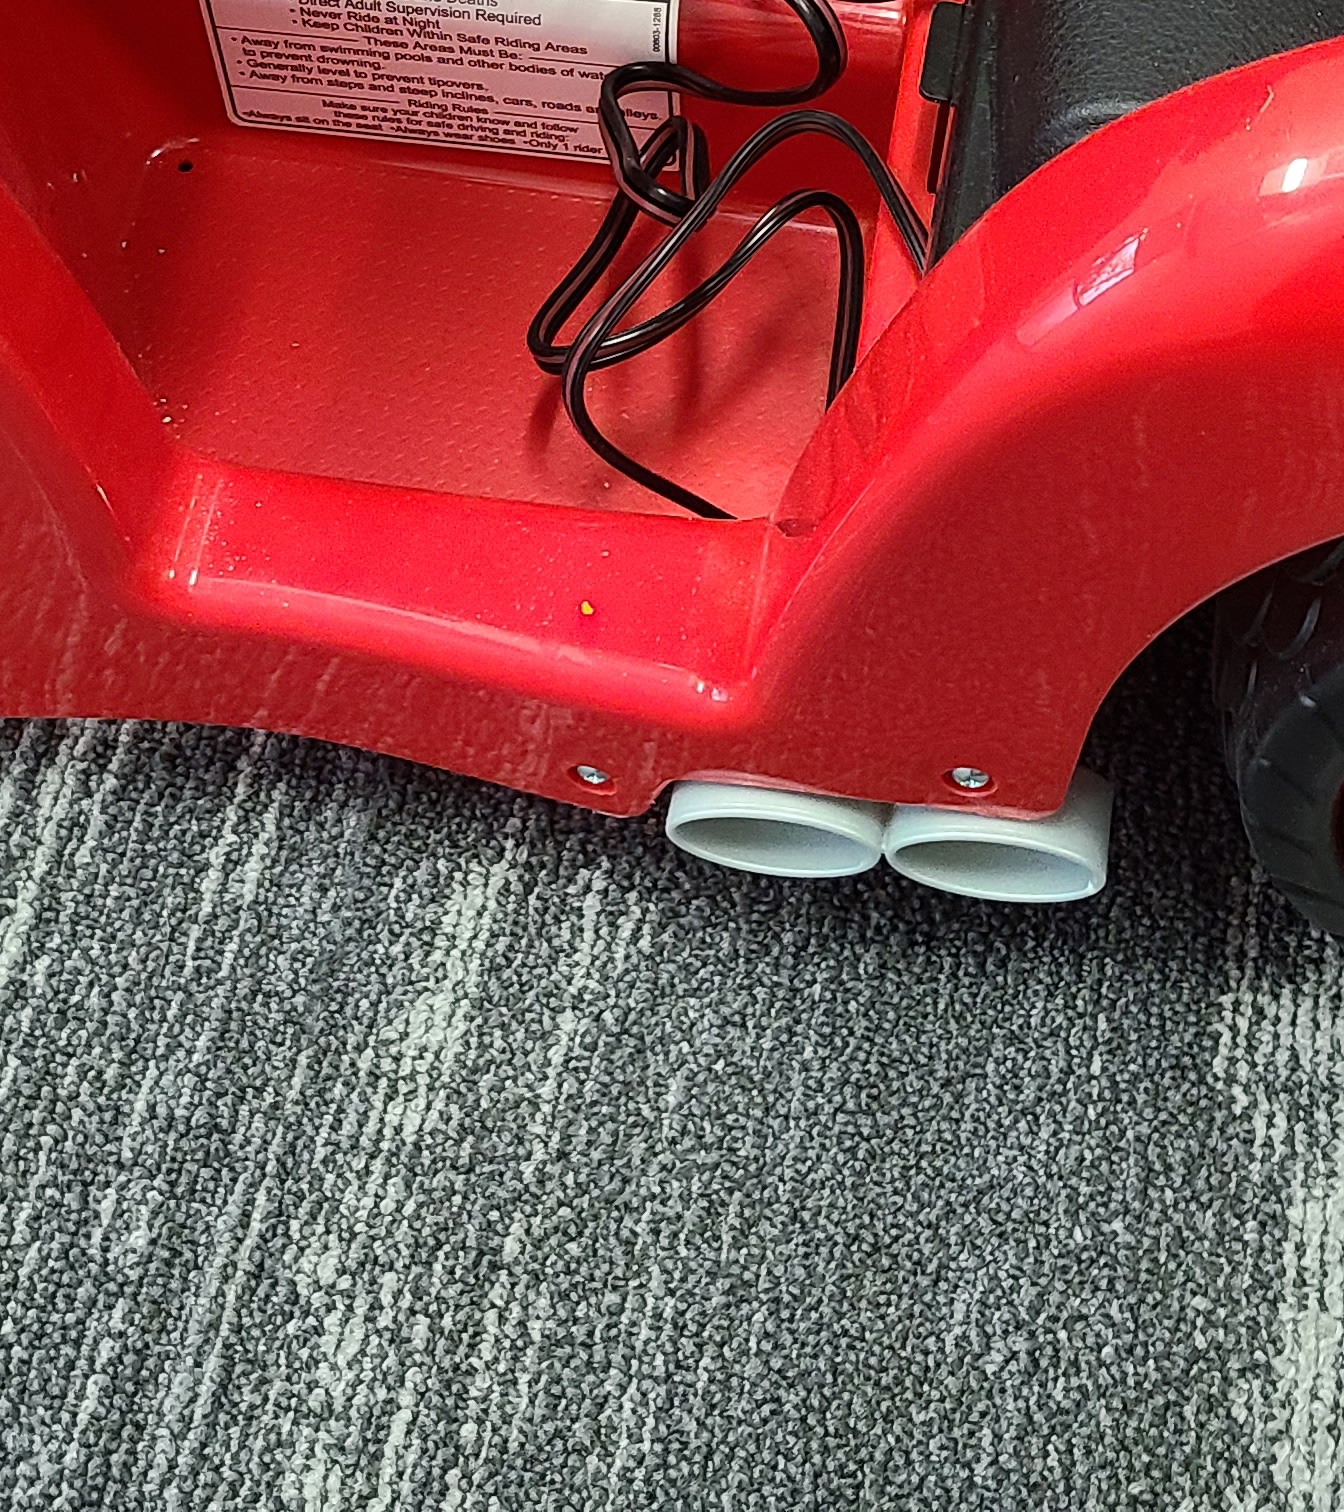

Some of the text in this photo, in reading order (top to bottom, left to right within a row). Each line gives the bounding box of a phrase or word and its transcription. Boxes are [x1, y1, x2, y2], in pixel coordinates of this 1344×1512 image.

[300, 7, 441, 30] Never Ride at Night
[385, 1, 471, 20] Supervision
[476, 9, 541, 25] Required
[302, 18, 588, 55] Keep Children Within Safe Riding Areas
[365, 37, 523, 61] These Areas Must Be:
[241, 36, 607, 81] Away from swimming pools and other bodies of wat
[242, 47, 385, 70] to prevent drowning.
[246, 58, 489, 91] Generally level to prevent tipovers.
[249, 70, 288, 84] Away
[291, 74, 323, 86] from
[327, 79, 364, 91] steps
[368, 83, 394, 93] and
[399, 86, 438, 99] steep
[442, 90, 499, 104] inclines,
[503, 97, 537, 108] cars,
[542, 101, 582, 112] roads
[408, 99, 489, 114] Riding Rules
[322, 99, 357, 110] Make
[361, 105, 388, 113] sure
[422, 111, 473, 122] children
[477, 116, 510, 126] know
[514, 120, 537, 129] and
[541, 122, 579, 133] follow
[333, 111, 570, 142] these rules for safe driving and riding:
[332, 119, 352, 128] the
[442, 131, 474, 140] wear
[477, 134, 515, 144] shoes
[529, 139, 558, 150] Only
[563, 142, 569, 151] 1
[573, 144, 603, 154] rider
